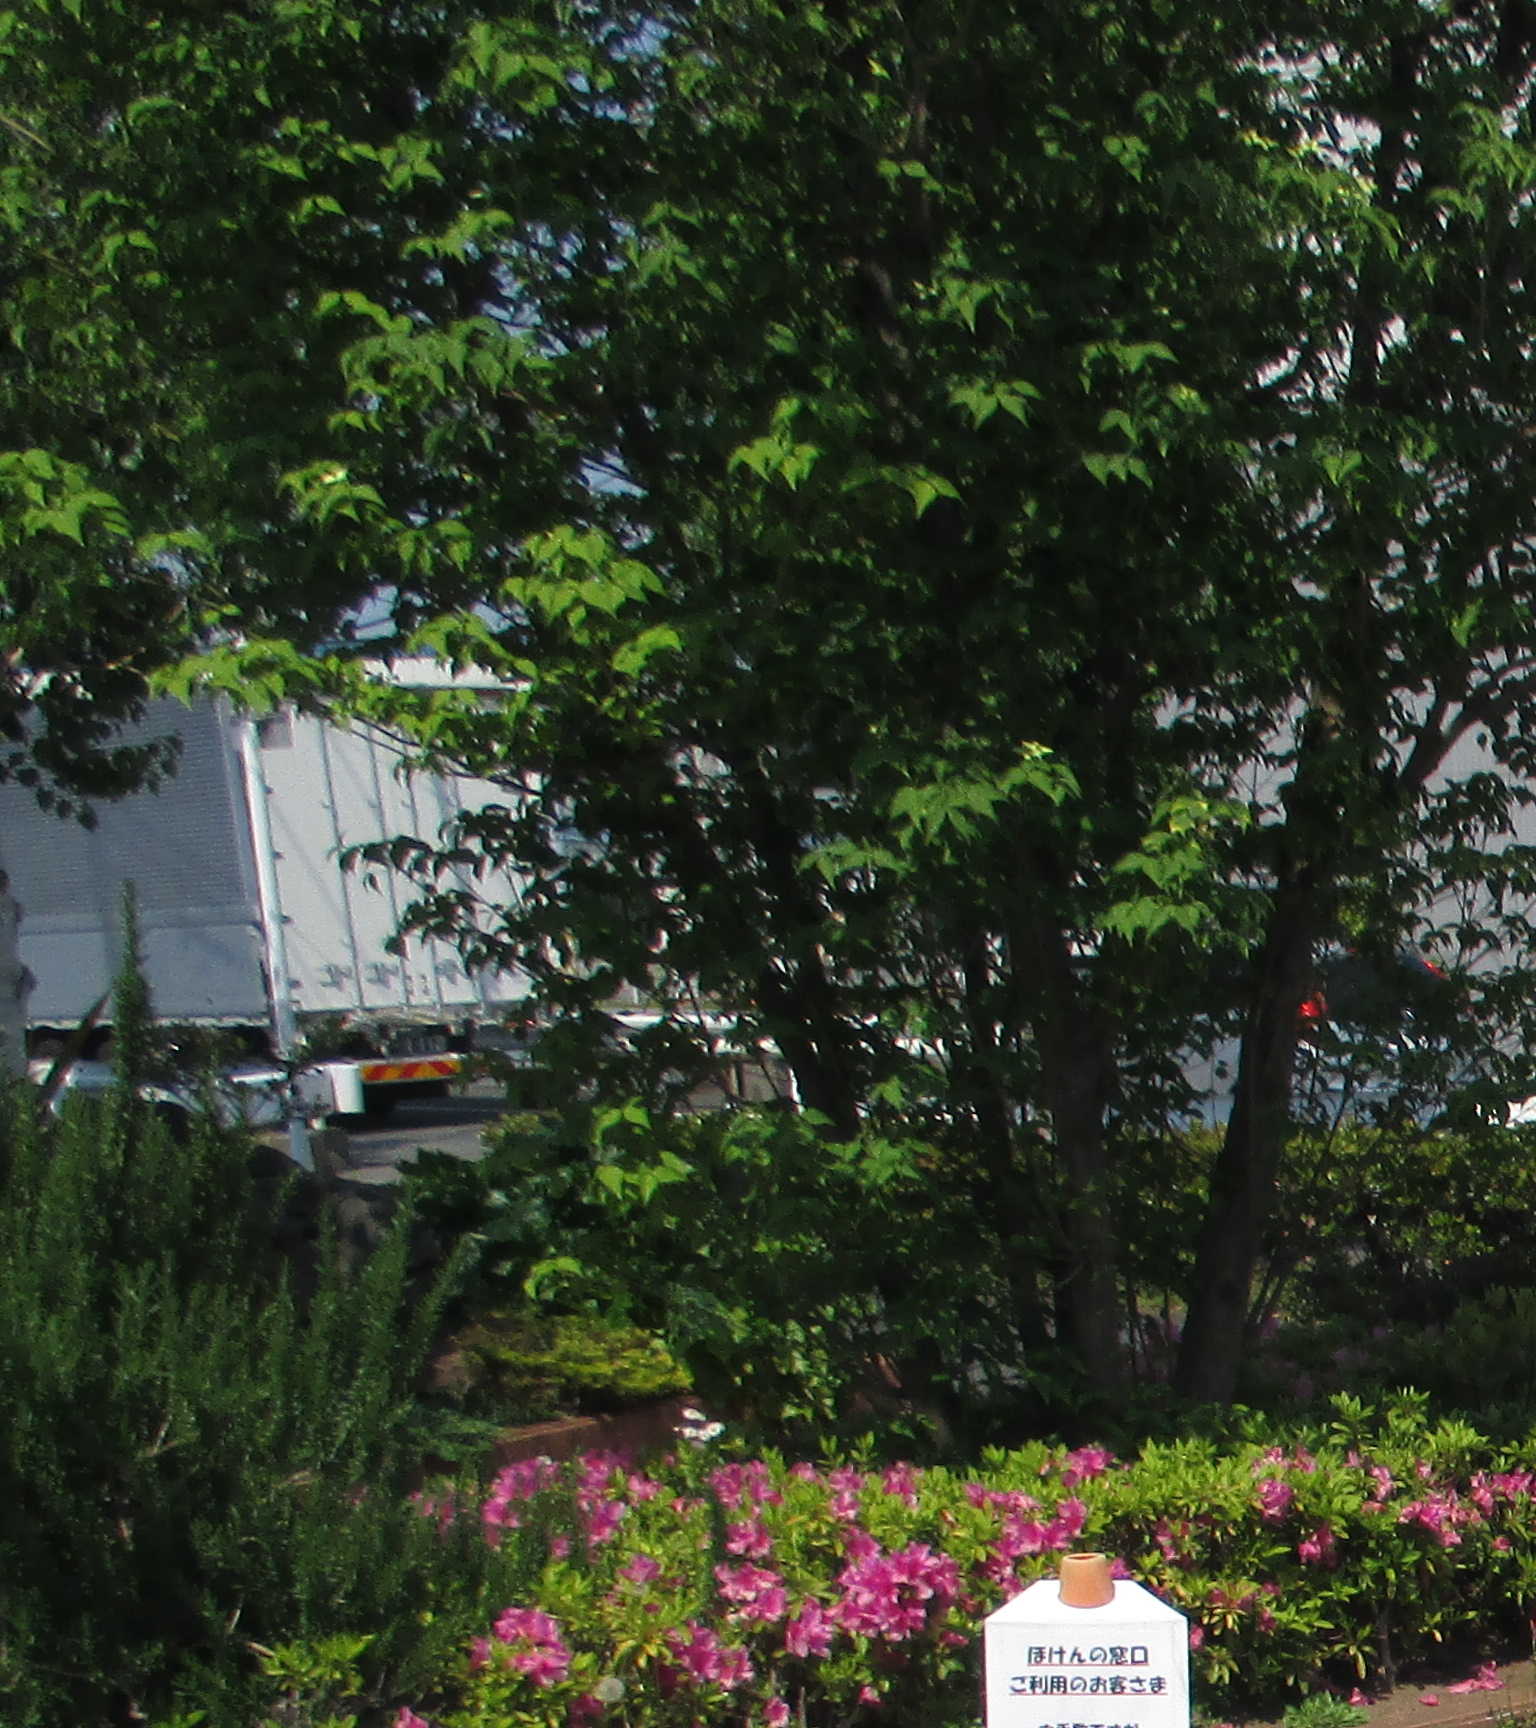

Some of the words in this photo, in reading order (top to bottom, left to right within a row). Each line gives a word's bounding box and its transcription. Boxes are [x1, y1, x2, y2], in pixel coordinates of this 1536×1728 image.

[1027, 1645, 1149, 1665] ほけんの窓口
[1008, 1675, 1168, 1694] ご利用のお客さま
